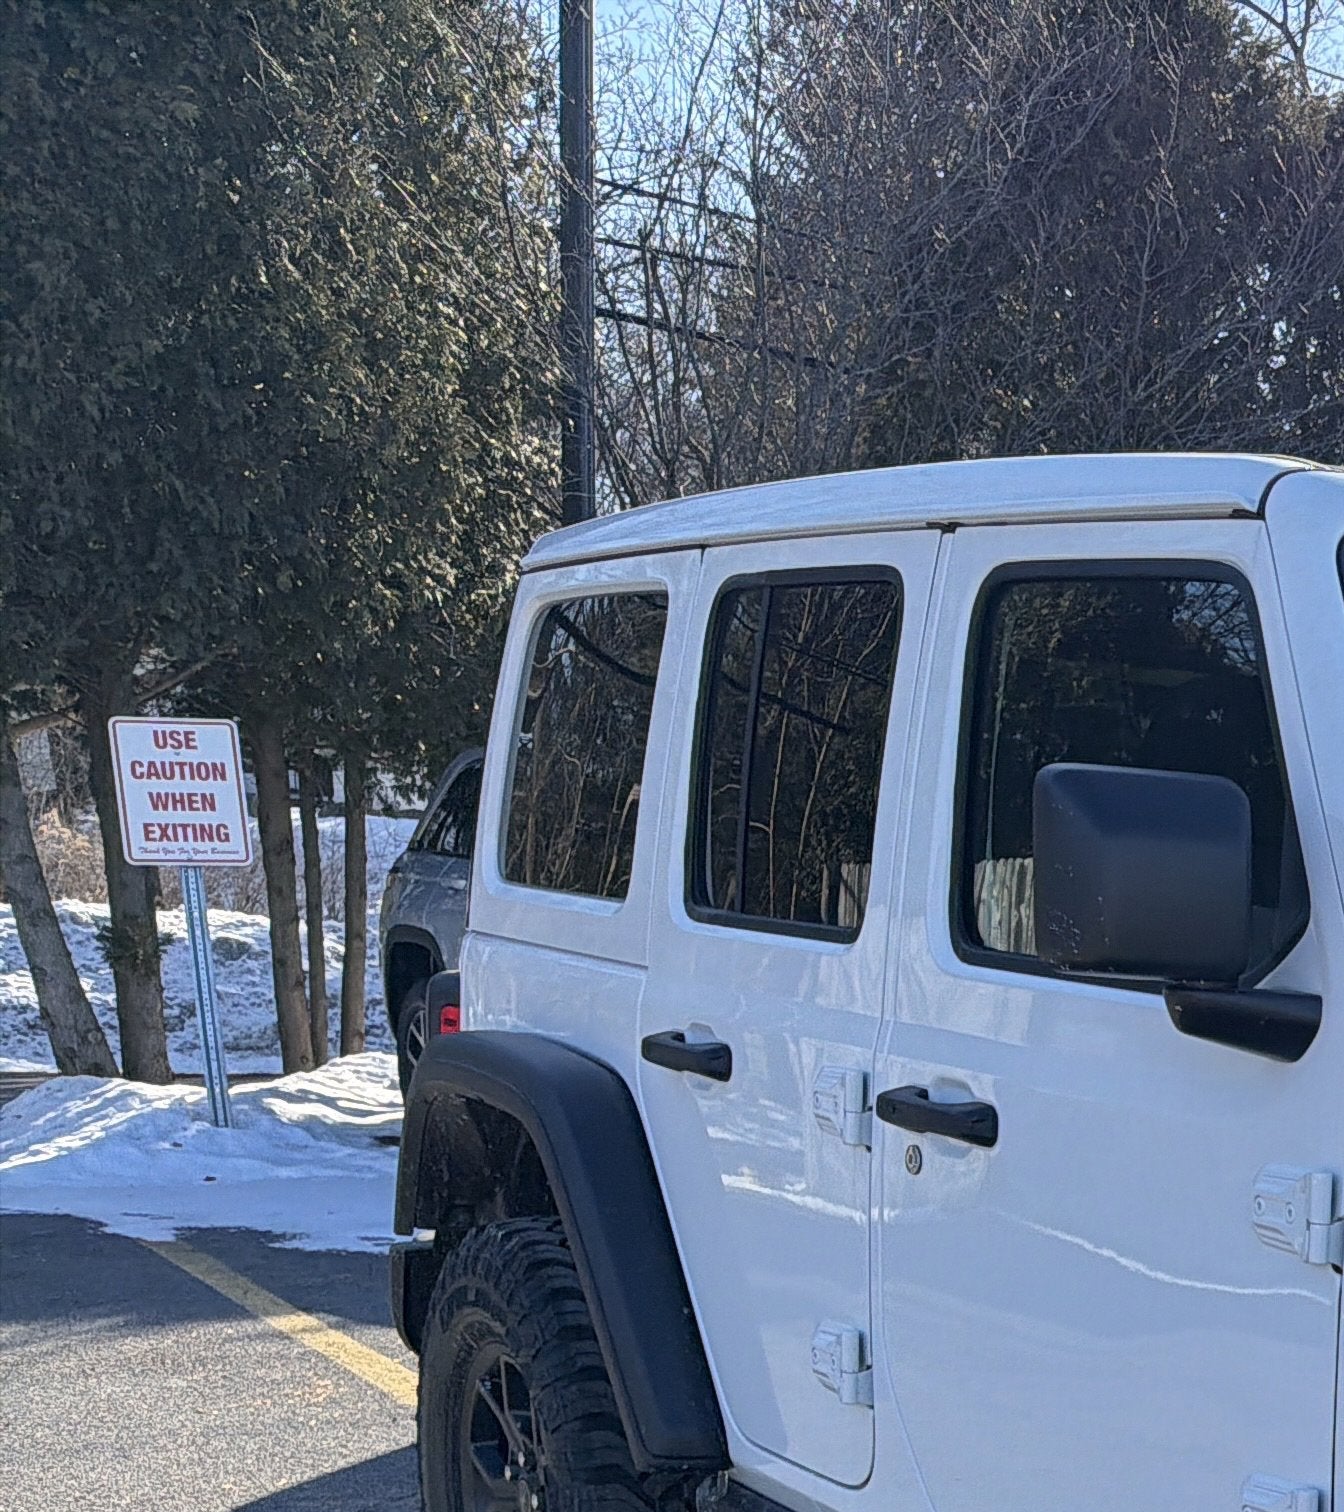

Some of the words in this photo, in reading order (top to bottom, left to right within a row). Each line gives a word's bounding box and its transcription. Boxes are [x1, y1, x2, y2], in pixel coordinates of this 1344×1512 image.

[153, 730, 198, 750] USE
[130, 760, 227, 781] CAUTION
[147, 791, 217, 812] WHEN
[142, 822, 231, 843] EXITING
